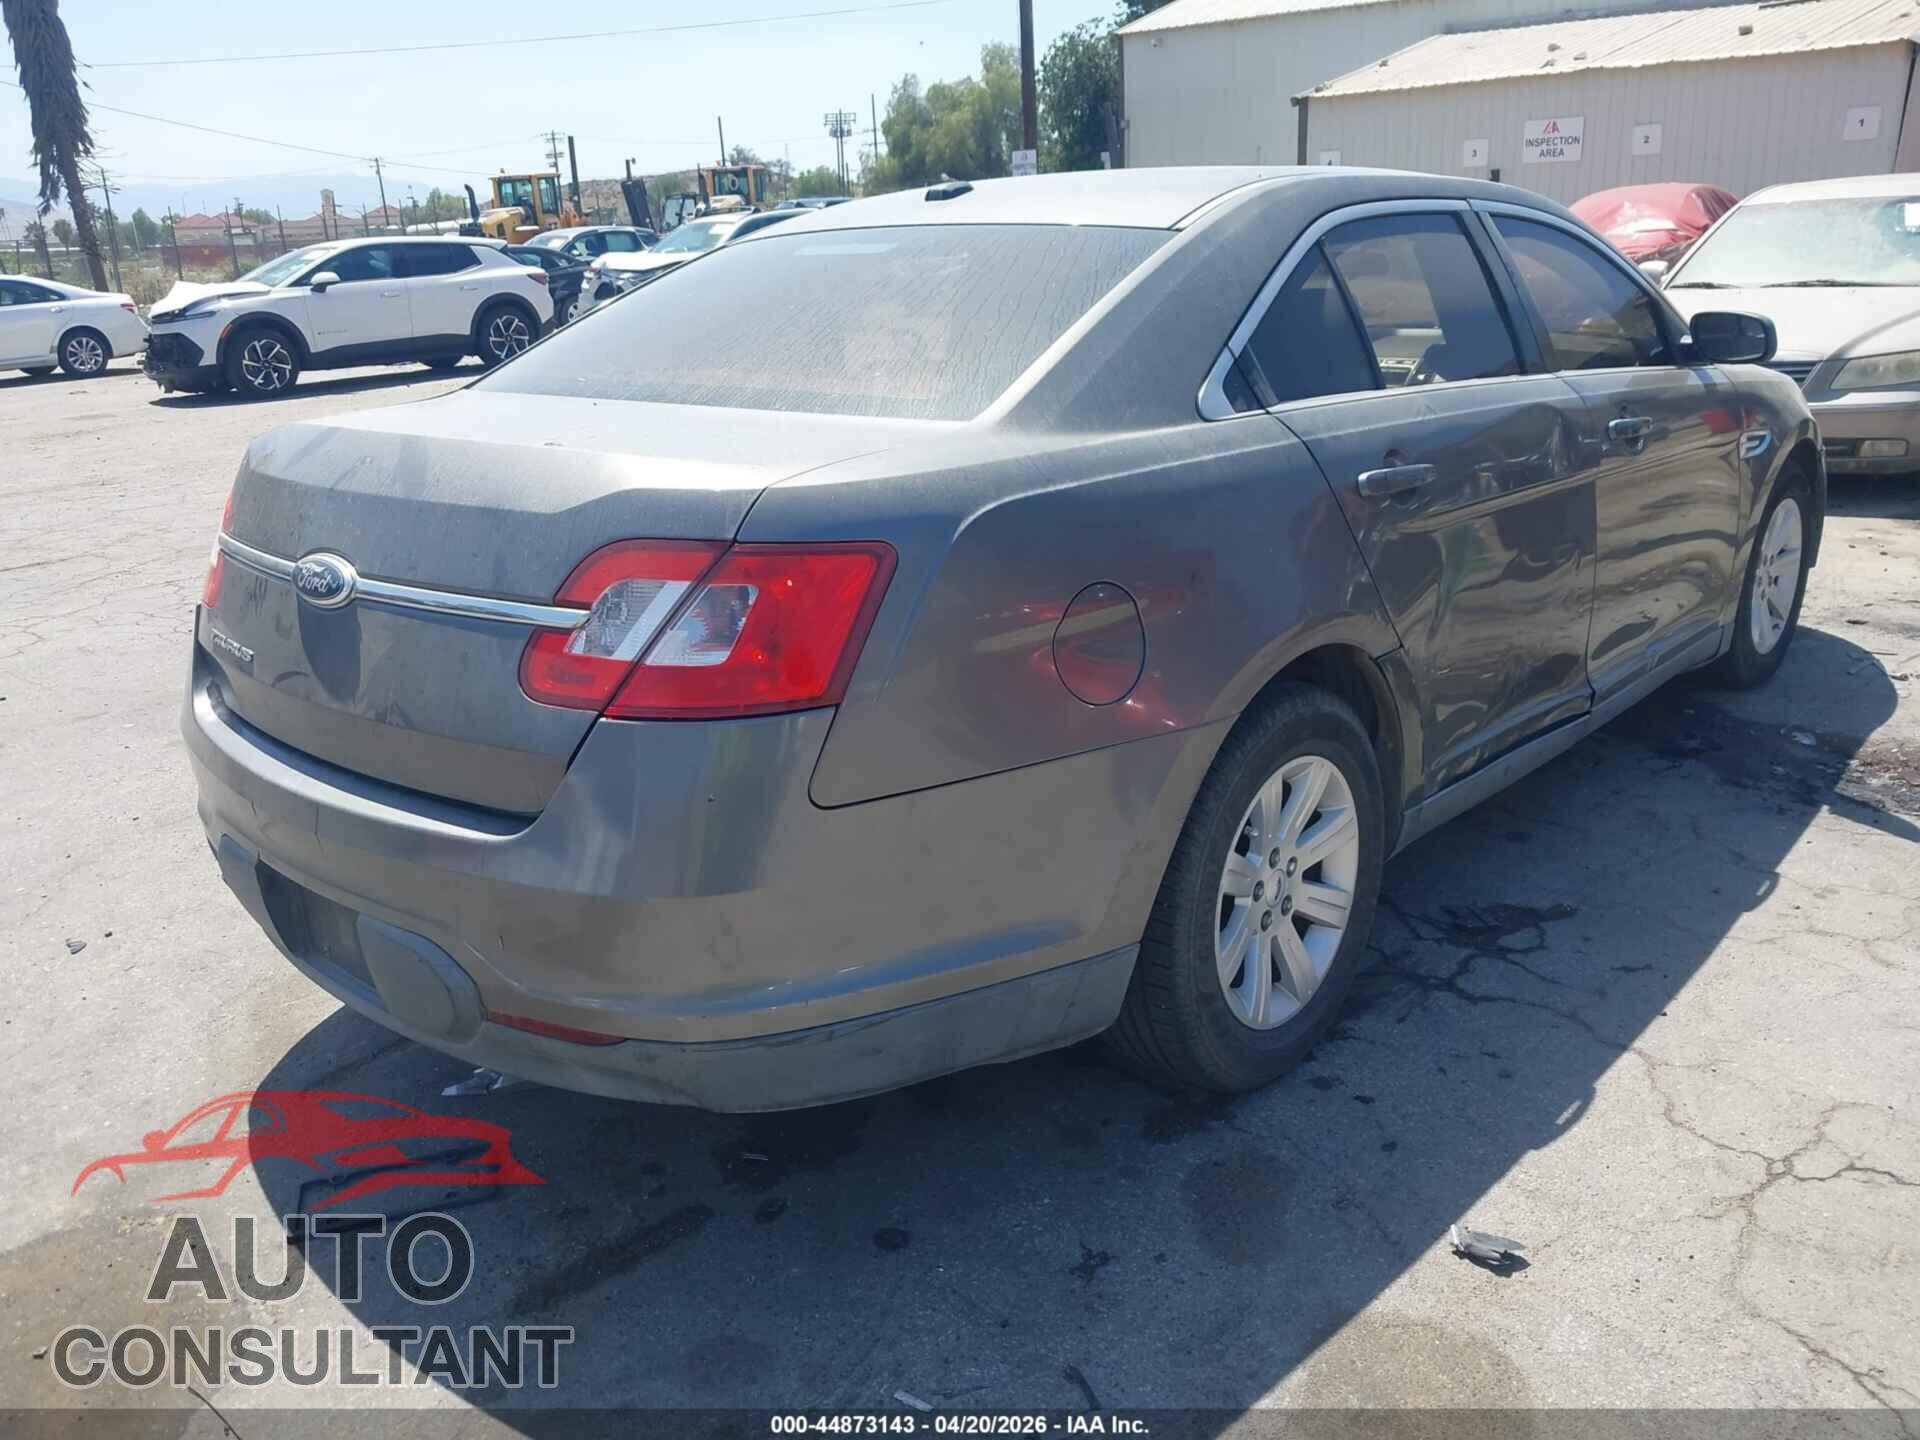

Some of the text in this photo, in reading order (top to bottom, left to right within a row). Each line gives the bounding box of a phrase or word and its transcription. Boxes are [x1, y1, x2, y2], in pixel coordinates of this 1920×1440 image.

[1525, 135, 1580, 147] INSPECTION
[1539, 147, 1565, 159] AREA
[298, 566, 332, 593] Ford
